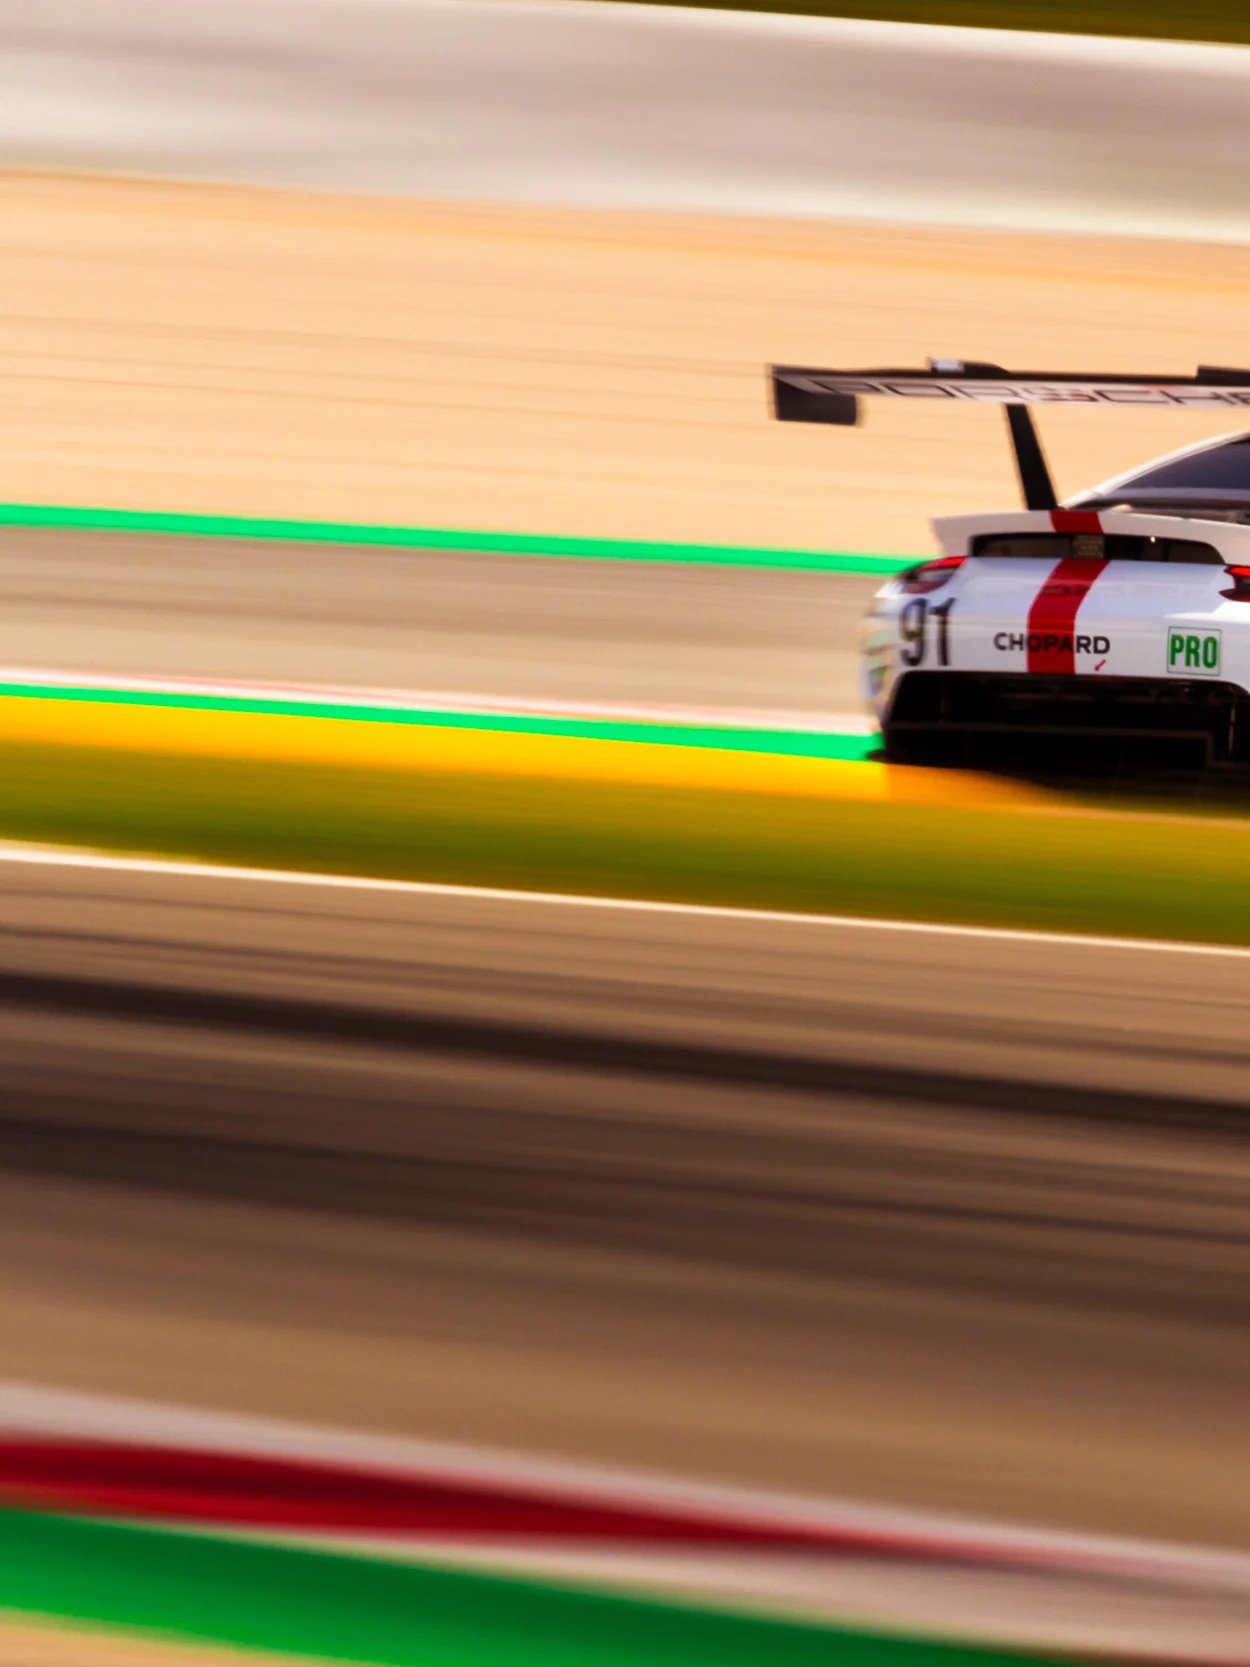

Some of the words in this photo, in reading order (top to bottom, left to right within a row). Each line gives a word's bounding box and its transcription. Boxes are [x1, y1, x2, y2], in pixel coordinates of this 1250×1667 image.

[899, 597, 957, 667] 91
[993, 632, 1110, 654] CHOPARD
[1170, 633, 1218, 669] PRO
